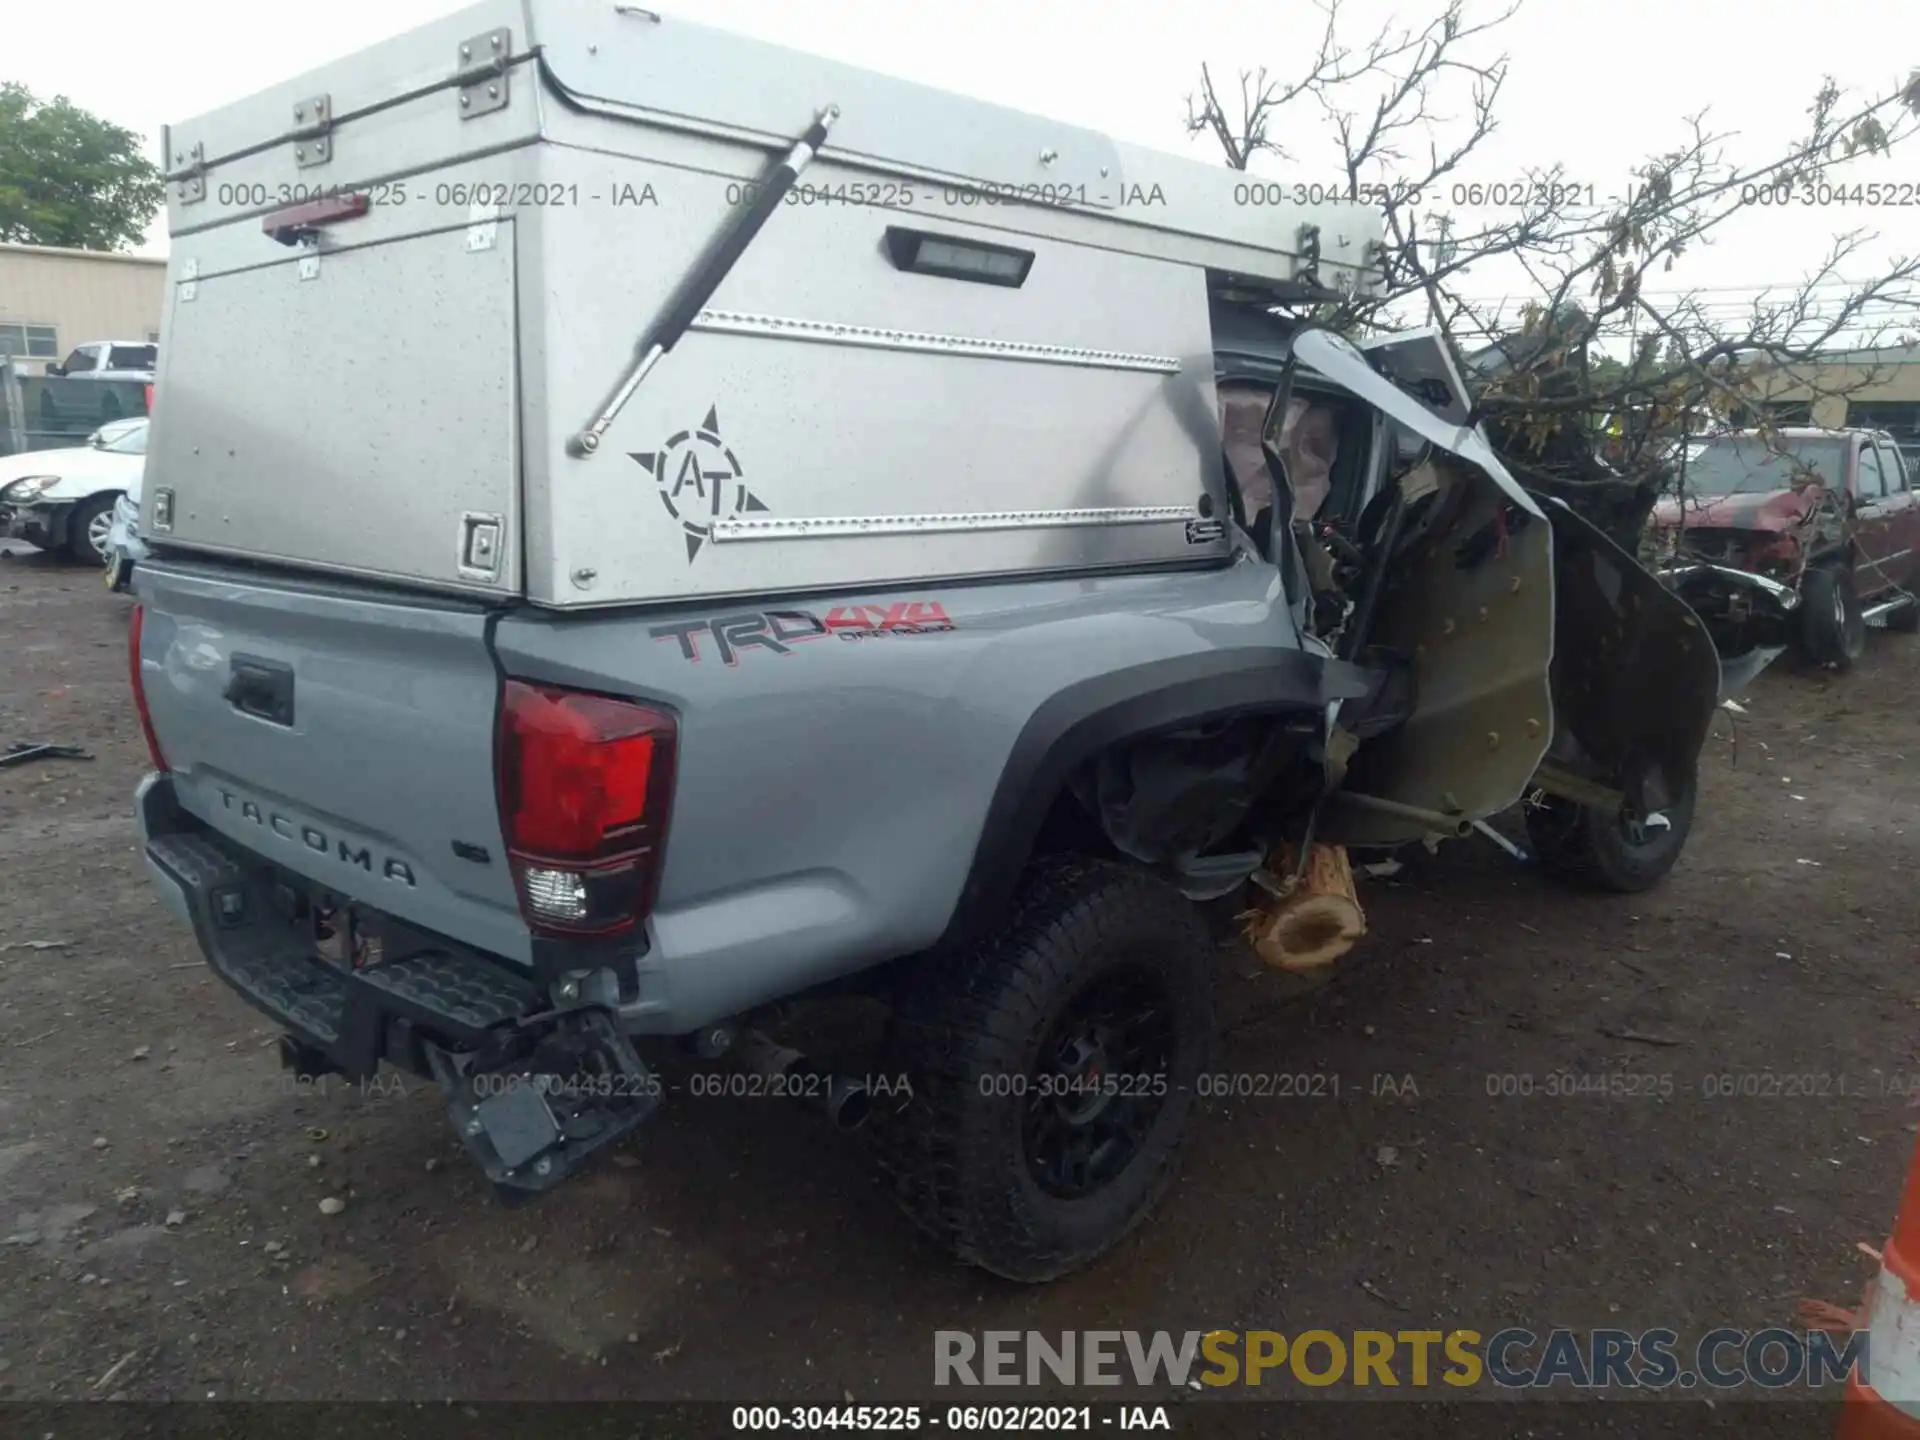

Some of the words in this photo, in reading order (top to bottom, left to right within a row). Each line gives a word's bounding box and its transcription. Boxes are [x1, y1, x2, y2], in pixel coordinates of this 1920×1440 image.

[671, 450, 732, 516] AT
[649, 610, 831, 667] TRD
[217, 789, 417, 890] TACOMA
